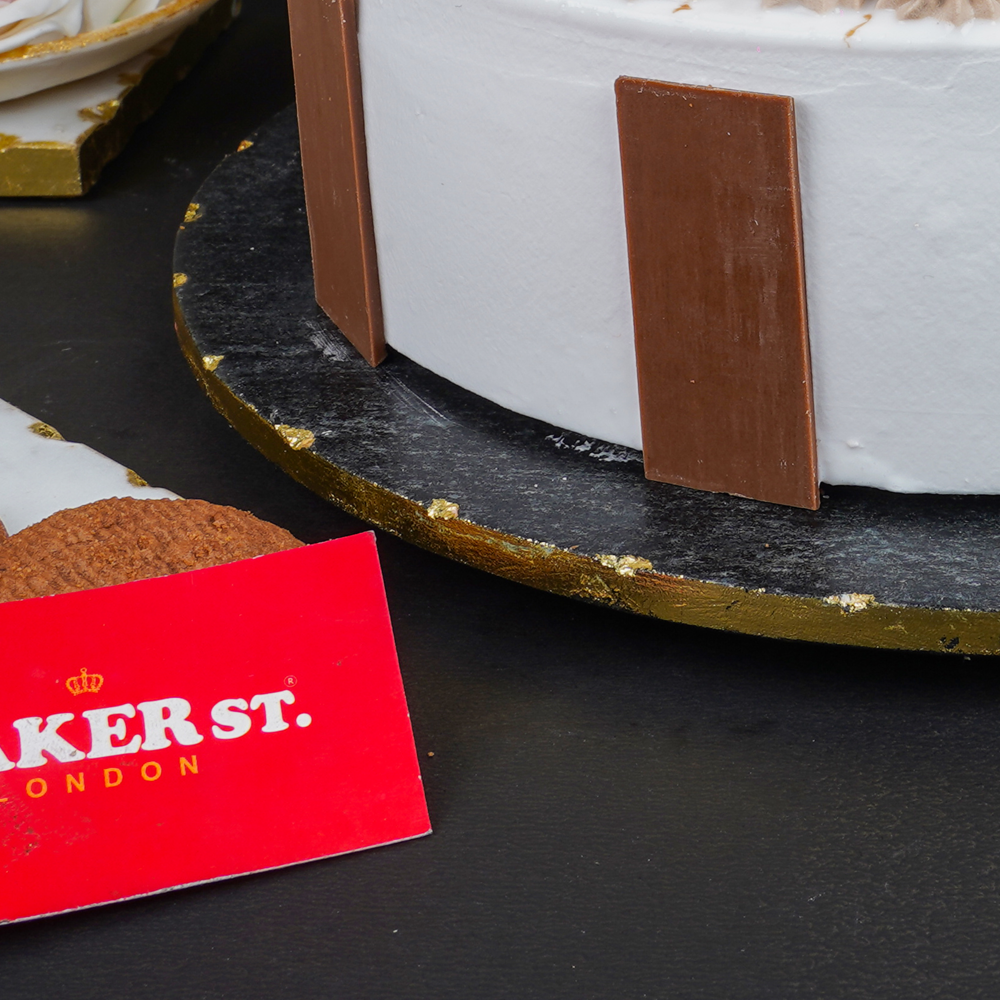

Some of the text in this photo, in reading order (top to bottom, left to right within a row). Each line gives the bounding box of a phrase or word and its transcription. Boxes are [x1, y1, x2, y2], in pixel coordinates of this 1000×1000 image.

[0, 690, 312, 771] KER ST.
[0, 755, 199, 802] ONDON
